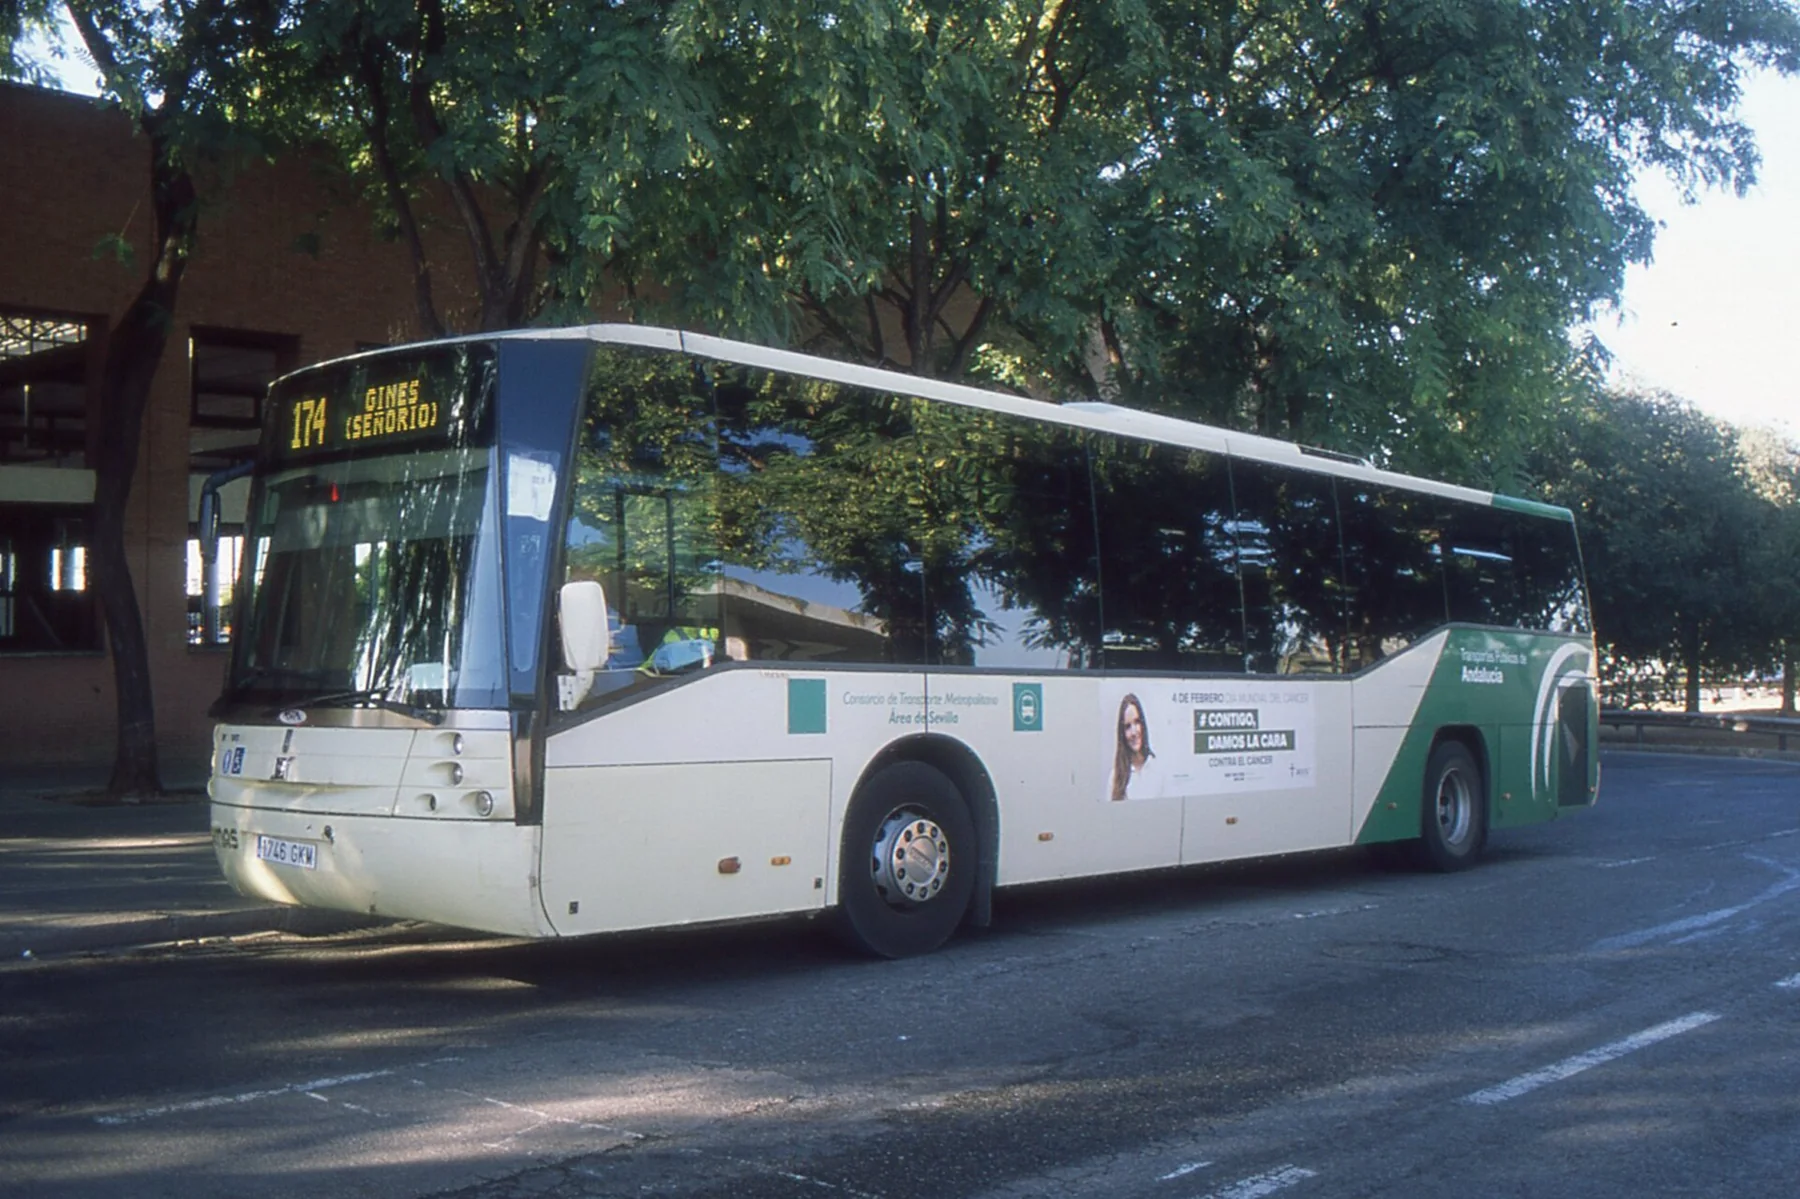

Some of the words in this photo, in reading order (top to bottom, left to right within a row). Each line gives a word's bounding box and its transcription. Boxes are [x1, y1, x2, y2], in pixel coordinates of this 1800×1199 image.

[364, 380, 420, 412] GINES
[292, 397, 326, 449] 174
[345, 401, 438, 440] (SEÑORIO)
[1461, 665, 1503, 683] Andalucía
[842, 691, 885, 705] Consorcio
[887, 693, 898, 705] de
[899, 692, 943, 707] Transporte
[945, 692, 999, 707] Metropolitano
[1171, 692, 1177, 703] 4
[1179, 692, 1189, 703] DE
[1191, 692, 1224, 703] FEBRERO
[888, 707, 912, 724] Área
[914, 711, 926, 724] de
[929, 710, 959, 724] Sevilla
[1208, 711, 1257, 728] CONTIGO,
[1208, 734, 1245, 750] DAMOS
[1247, 734, 1260, 748] LA
[1261, 733, 1288, 747] CARA
[1208, 756, 1236, 768] CONTRA
[1238, 756, 1245, 766] EL
[262, 838, 287, 861] 1746
[290, 844, 314, 866] GKW
